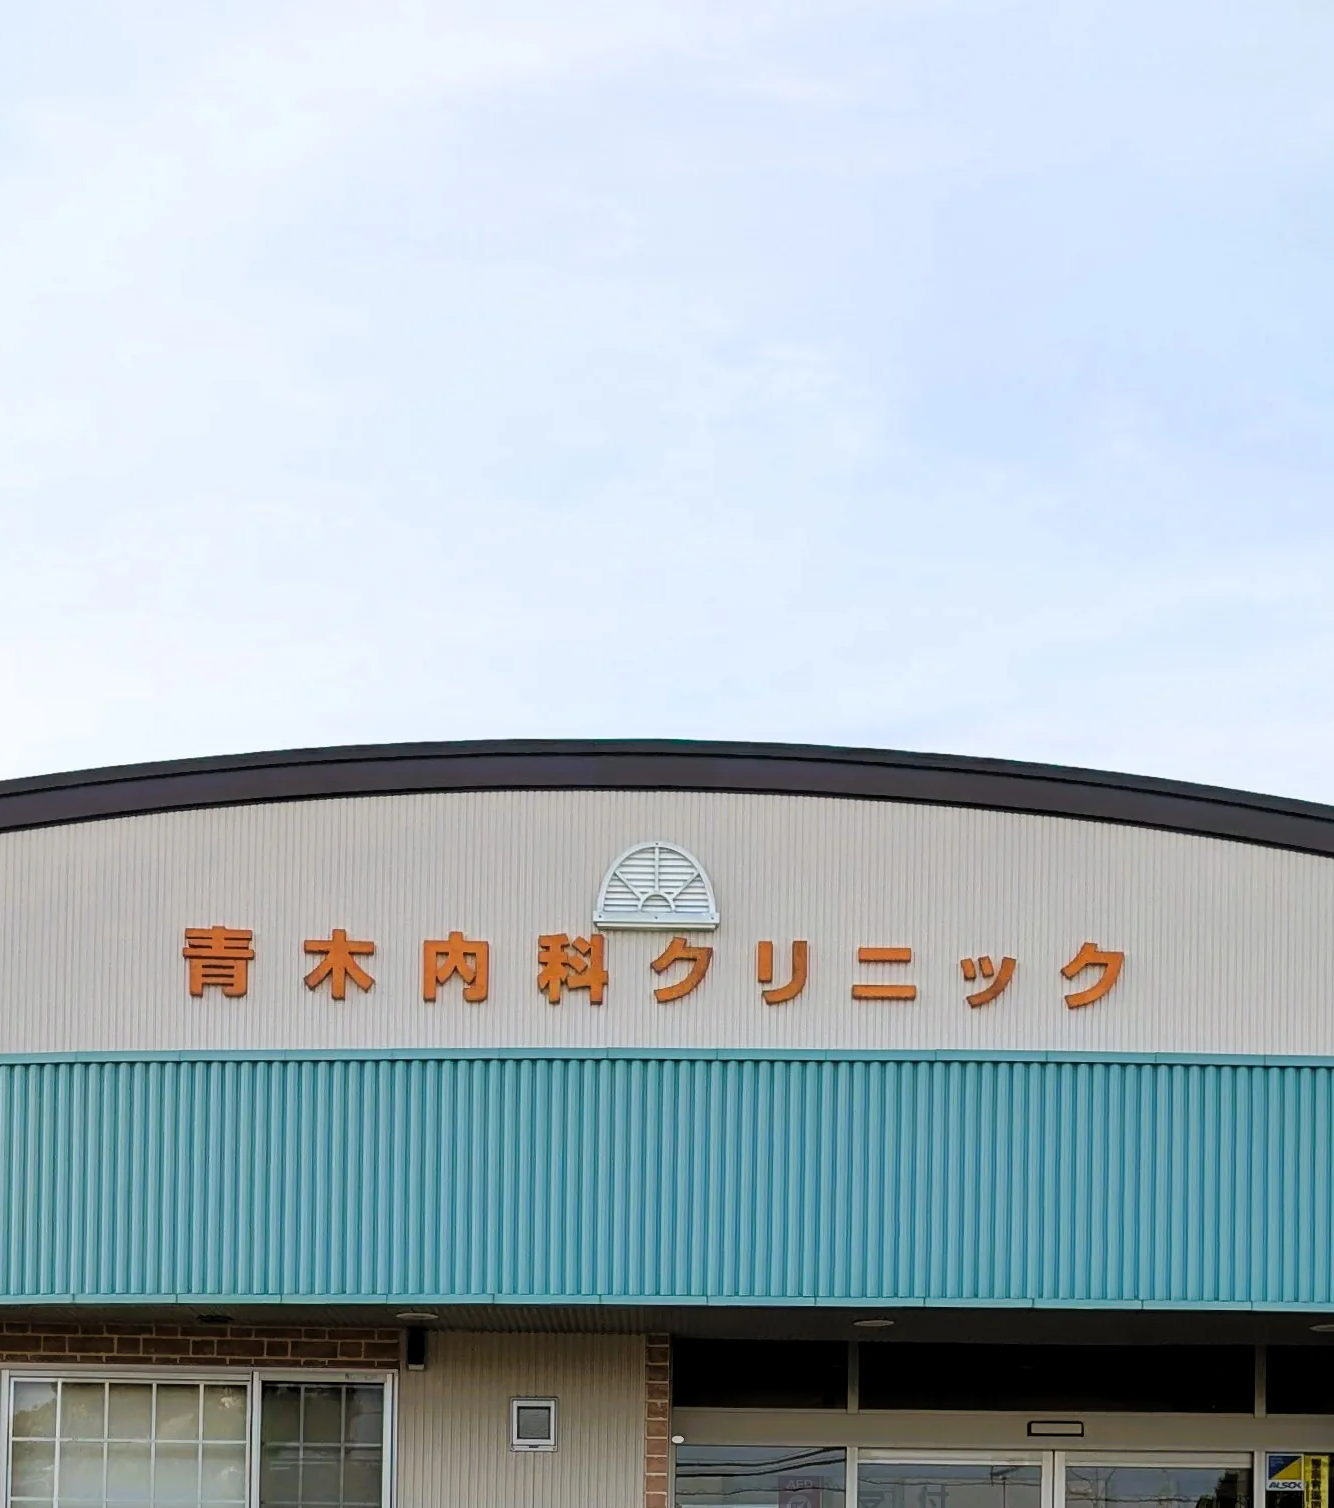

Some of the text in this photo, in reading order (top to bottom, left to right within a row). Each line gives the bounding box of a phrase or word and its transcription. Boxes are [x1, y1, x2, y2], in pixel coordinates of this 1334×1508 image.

[183, 926, 1125, 1008] 青木内科クリニック
[1268, 1481, 1302, 1489] ALSOK
